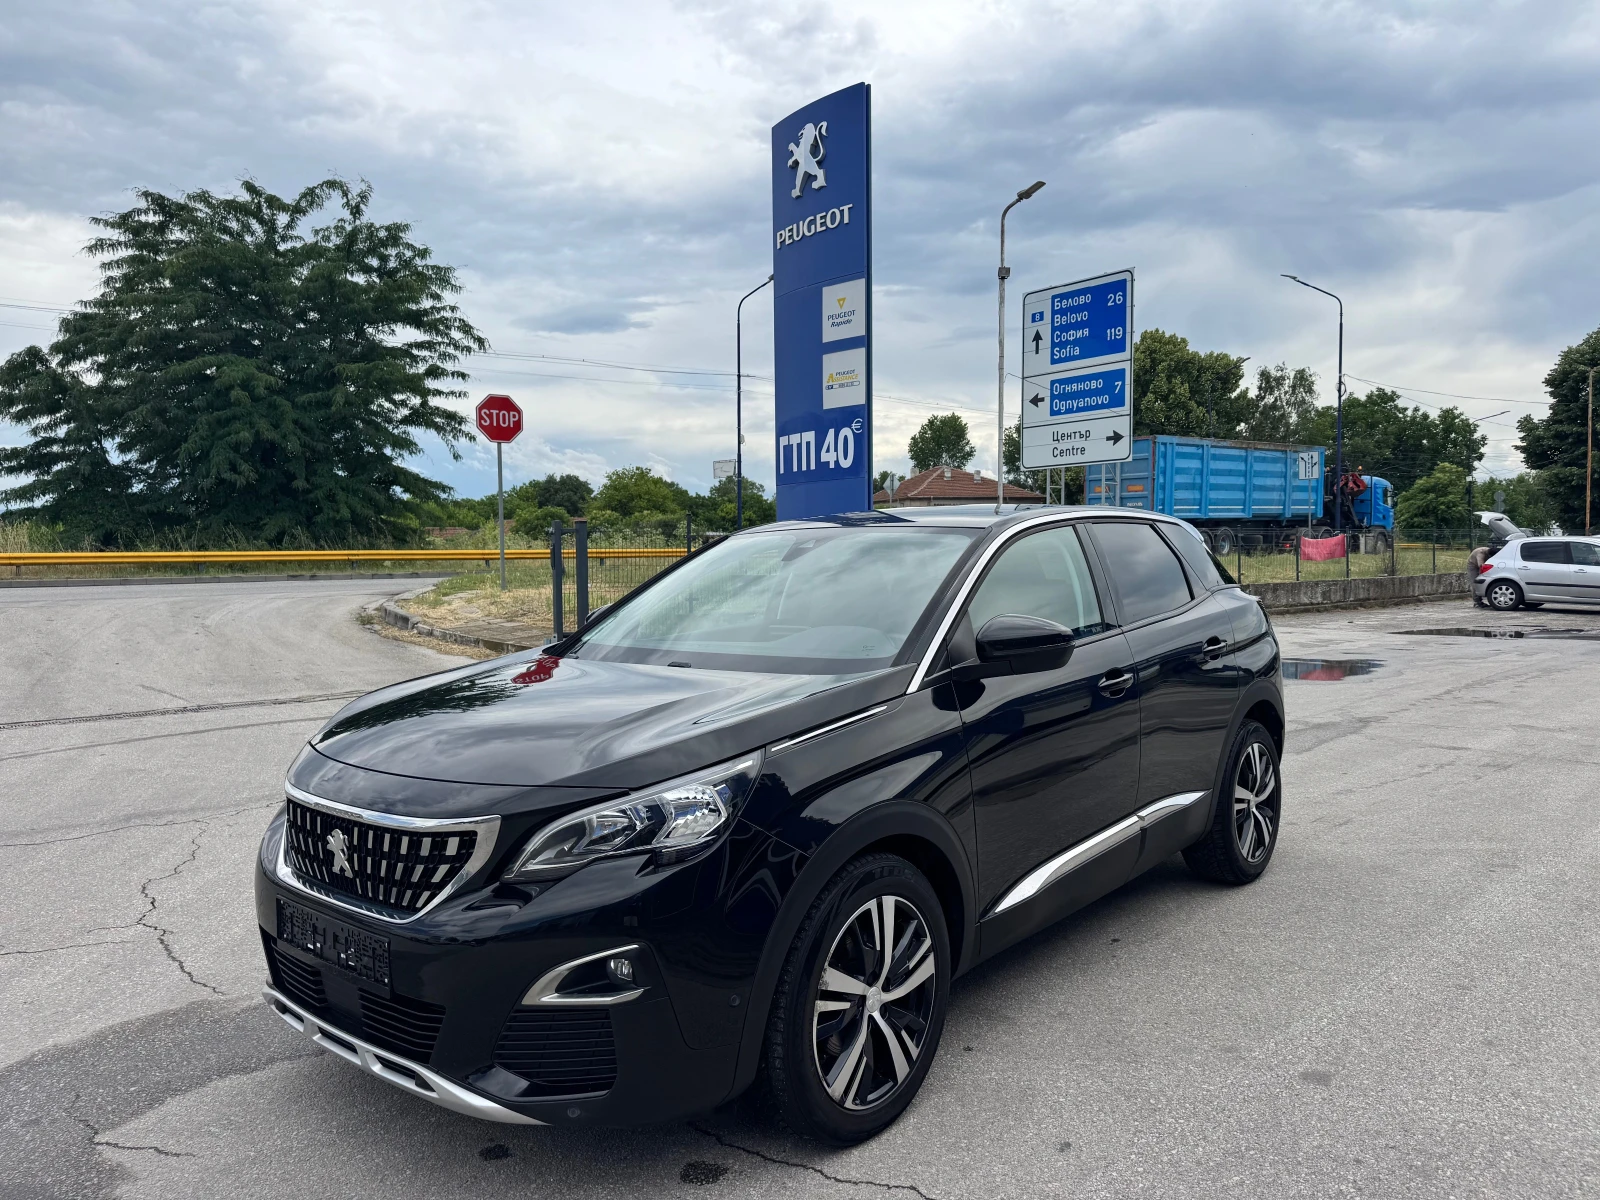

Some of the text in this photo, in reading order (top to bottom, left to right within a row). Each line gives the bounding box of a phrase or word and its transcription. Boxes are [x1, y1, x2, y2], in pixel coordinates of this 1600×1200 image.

[776, 203, 853, 250] PEUGEOT
[1054, 292, 1123, 310] Белово 26
[827, 309, 856, 321] PEUGEOT
[1035, 313, 1040, 322] 8
[1054, 311, 1089, 326] Belovo
[1053, 326, 1123, 343] София 119
[1053, 345, 1080, 359] Sofia
[1053, 379, 1122, 395] Огняново 7
[1053, 395, 1109, 413] Ognyanovo
[480, 408, 519, 428] STOP
[1052, 429, 1091, 444] Център
[779, 430, 816, 475] ГТП
[1052, 445, 1086, 458] Centre
